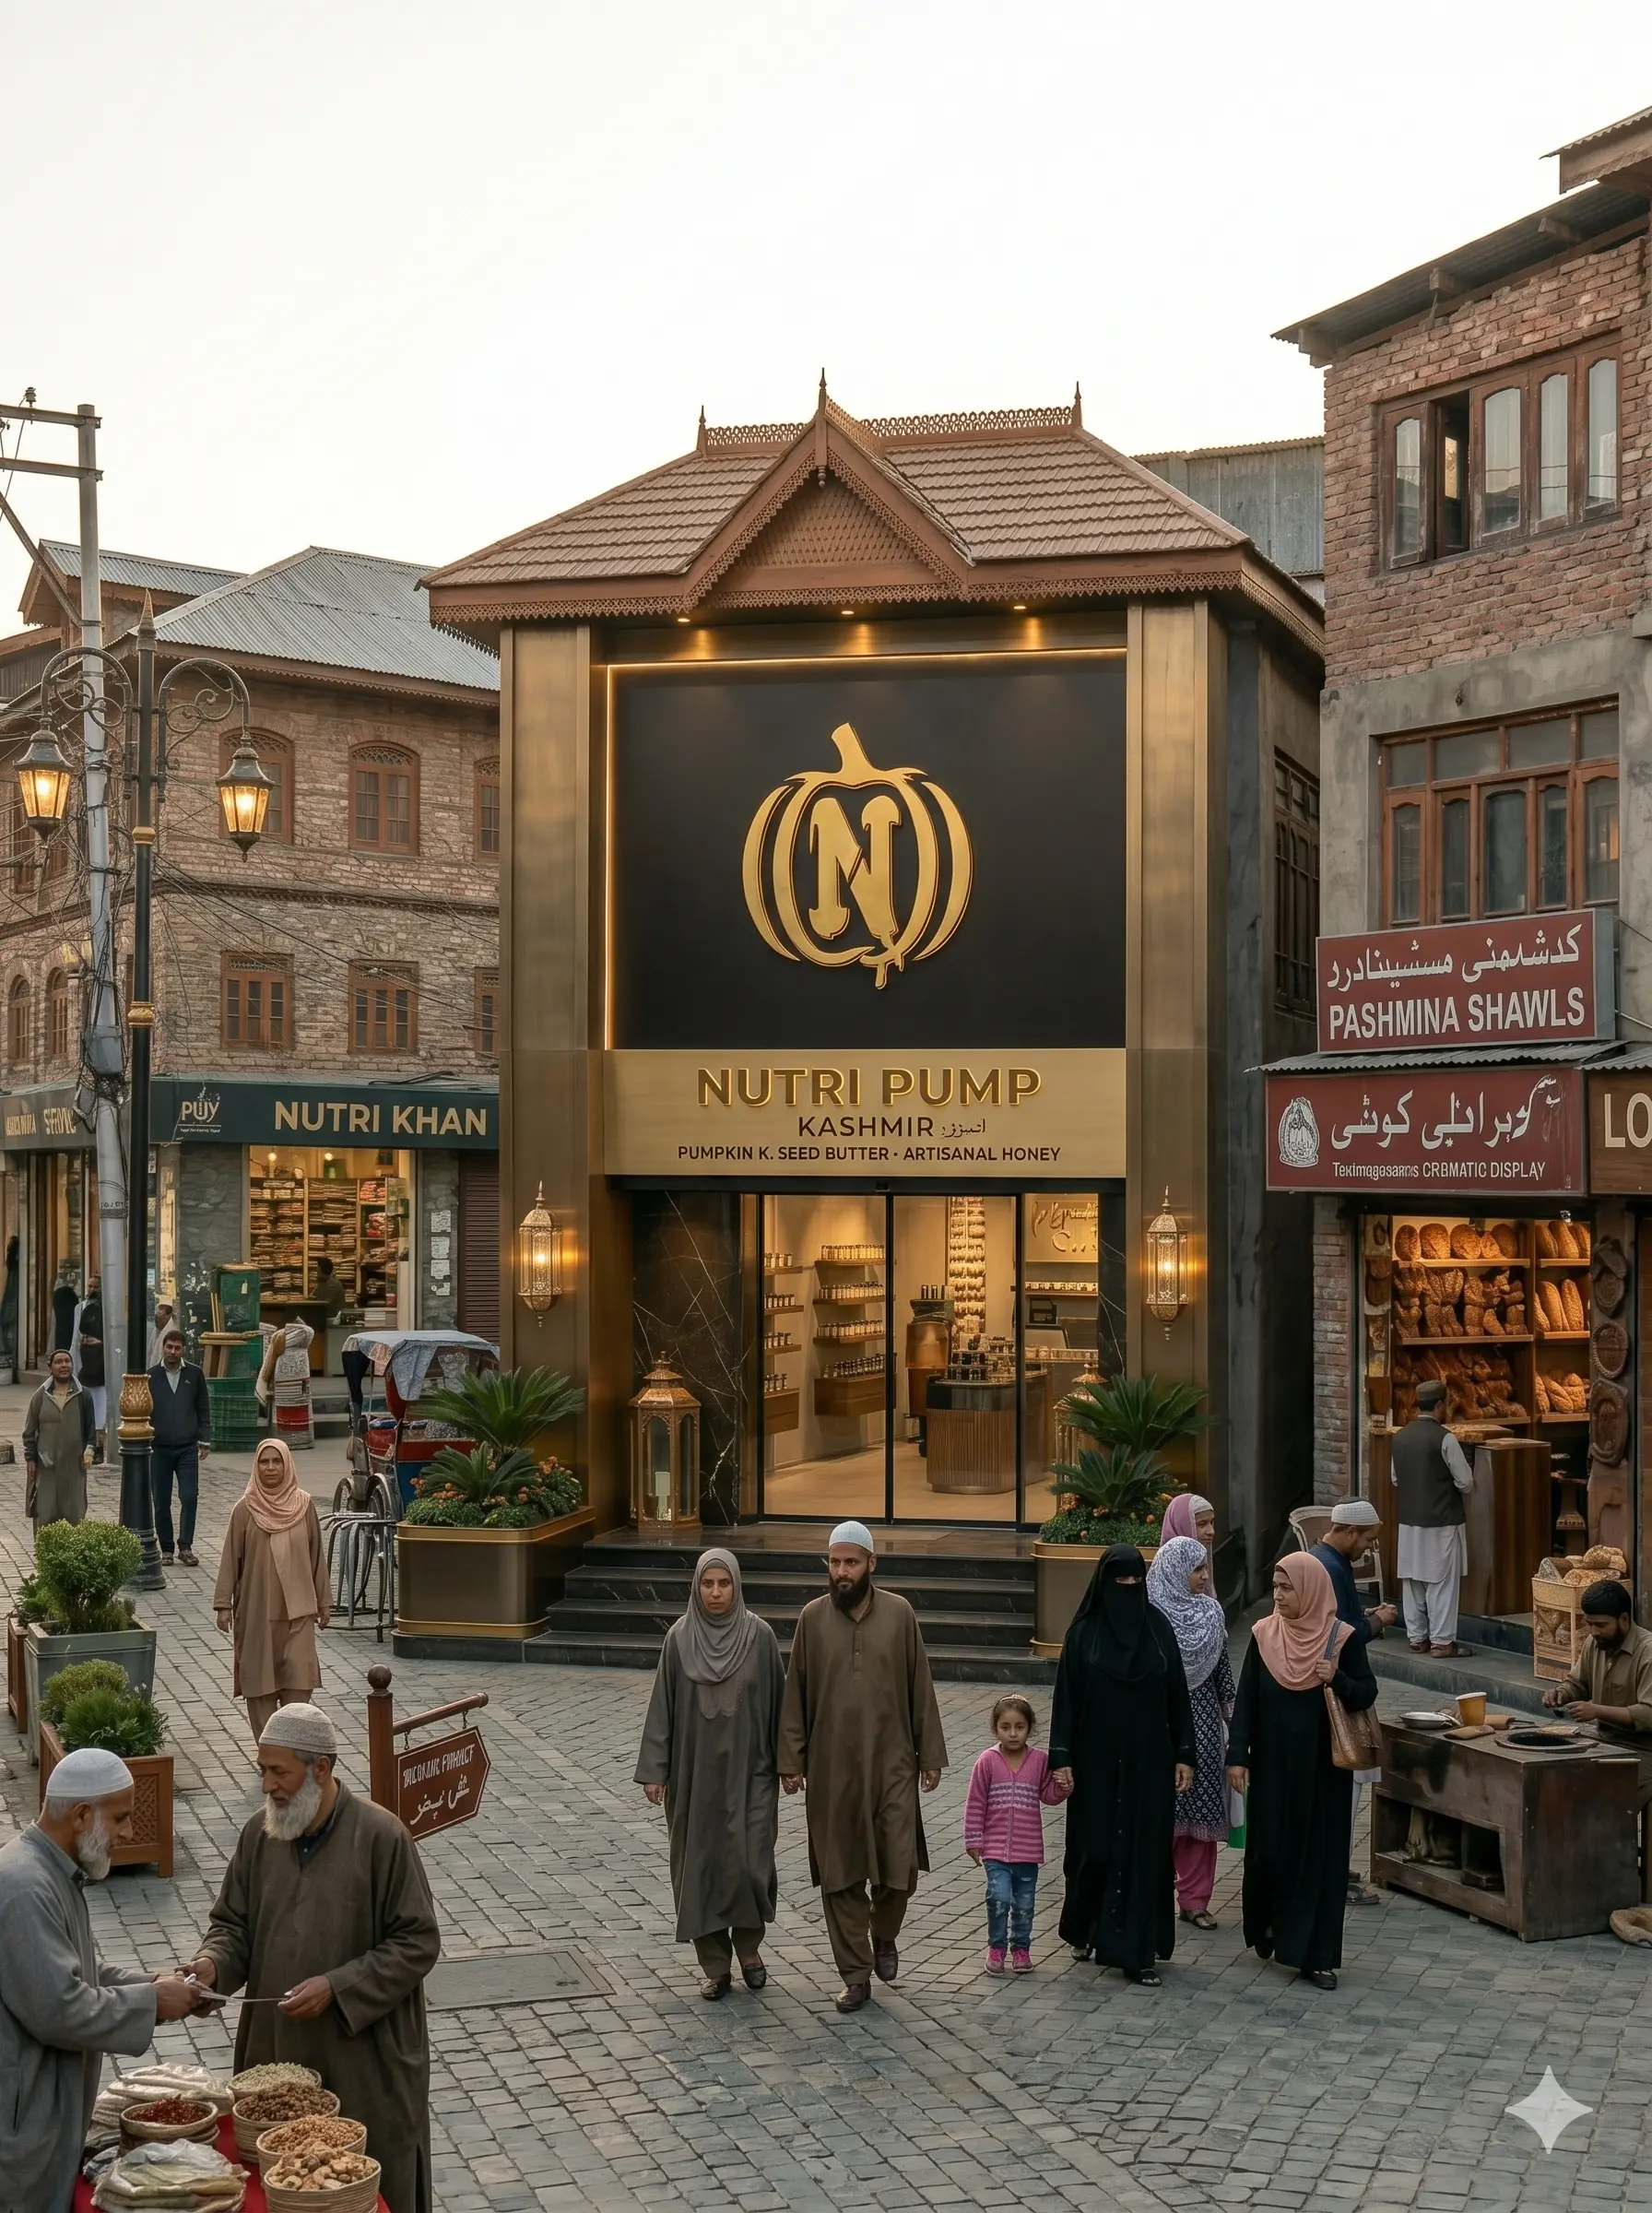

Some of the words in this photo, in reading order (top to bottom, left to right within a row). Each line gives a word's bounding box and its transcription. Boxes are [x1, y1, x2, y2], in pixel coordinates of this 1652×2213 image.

[1329, 996, 1460, 1041] PASHMINA
[1467, 987, 1585, 1033] SHAWLS
[697, 1066, 861, 1107] NUTRI
[881, 1066, 1043, 1107] PUMP
[275, 1101, 380, 1134] NUTRI
[393, 1106, 487, 1136] KHAN
[798, 1116, 934, 1138] KASHMIR
[1604, 1092, 1652, 1149] LO
[678, 1146, 752, 1161] PUMPKIN
[759, 1146, 774, 1161] K.
[777, 1146, 820, 1161] SEED
[825, 1146, 890, 1162] BUTTER
[903, 1146, 998, 1162] ARTISANAL
[1002, 1146, 1061, 1162] HONEY
[1490, 1162, 1546, 1180] DISPLAY
